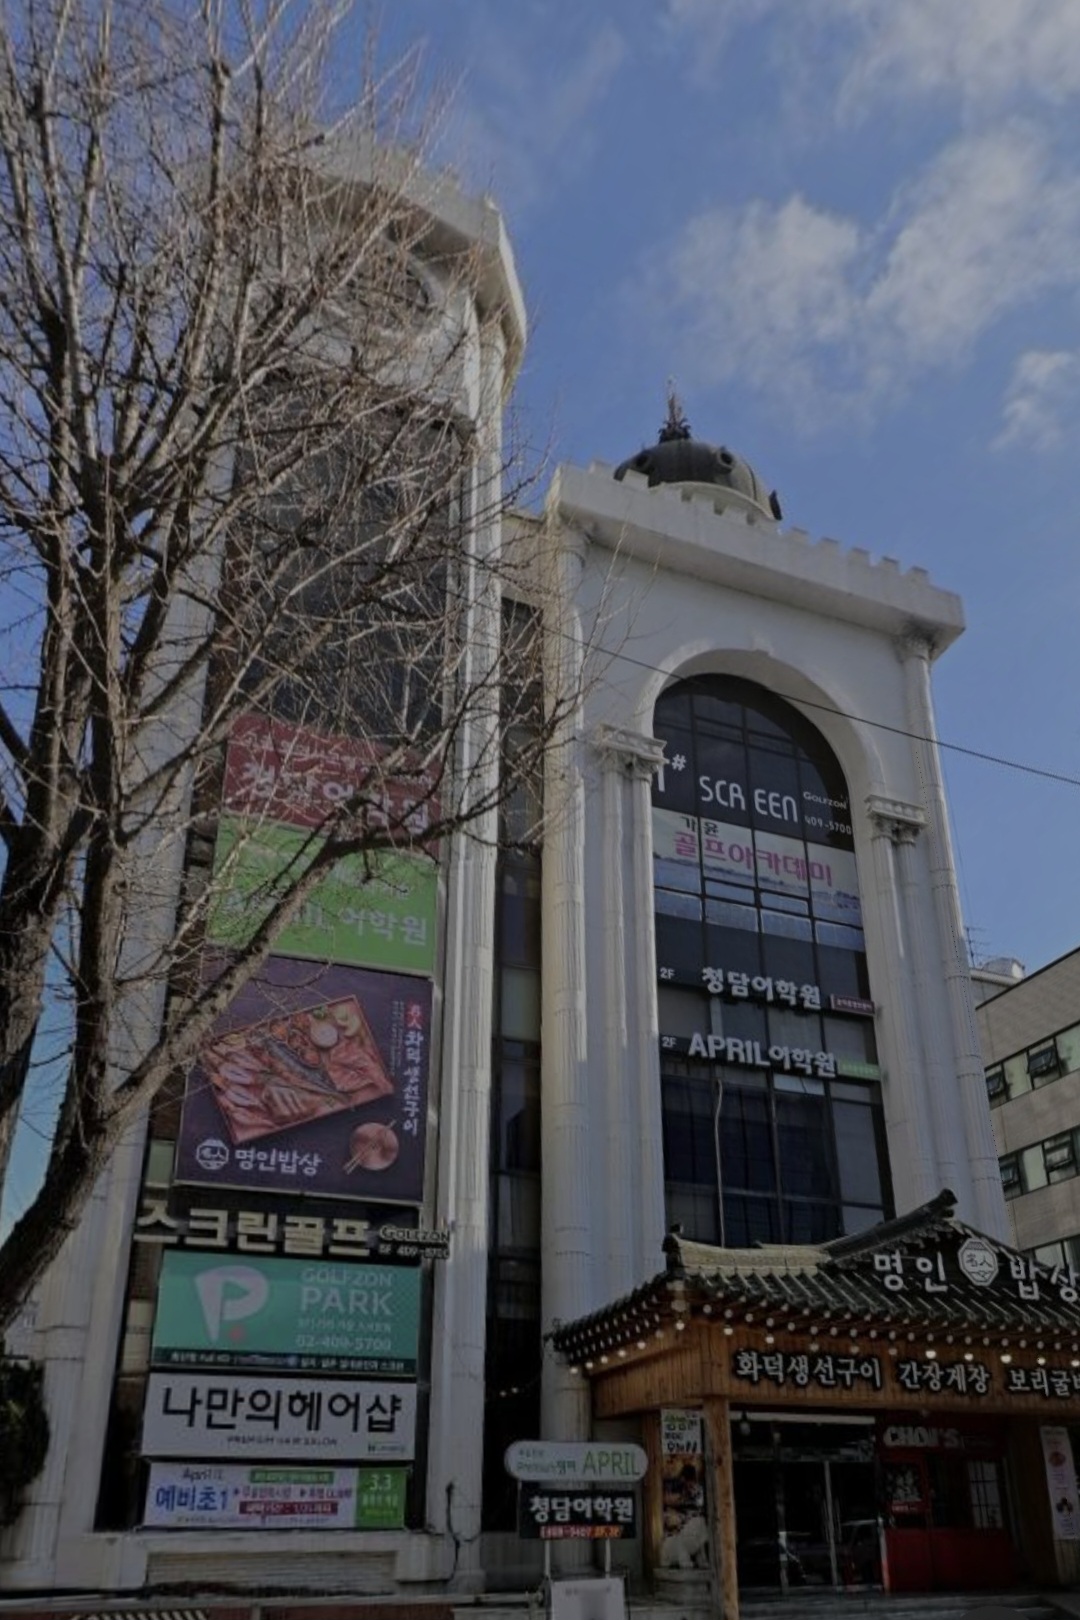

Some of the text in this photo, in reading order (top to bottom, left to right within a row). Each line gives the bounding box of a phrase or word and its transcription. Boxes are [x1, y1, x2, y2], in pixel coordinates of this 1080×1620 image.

[804, 815, 852, 836] 409-5700
[674, 832, 834, 887] 골프아카데미
[702, 966, 822, 1010] 청담어학원
[235, 1147, 323, 1175] 명인밥상
[133, 1200, 371, 1257] 스크린골프
[302, 1267, 393, 1287] GOLFZON
[302, 1286, 394, 1315] PARK
[736, 1351, 882, 1389] 화덕생선구이
[900, 1361, 990, 1394] 간장게장
[162, 1387, 402, 1433] 나만의헤어샵
[582, 1450, 641, 1476] APRIL
[529, 1494, 635, 1523] 청담어학원
